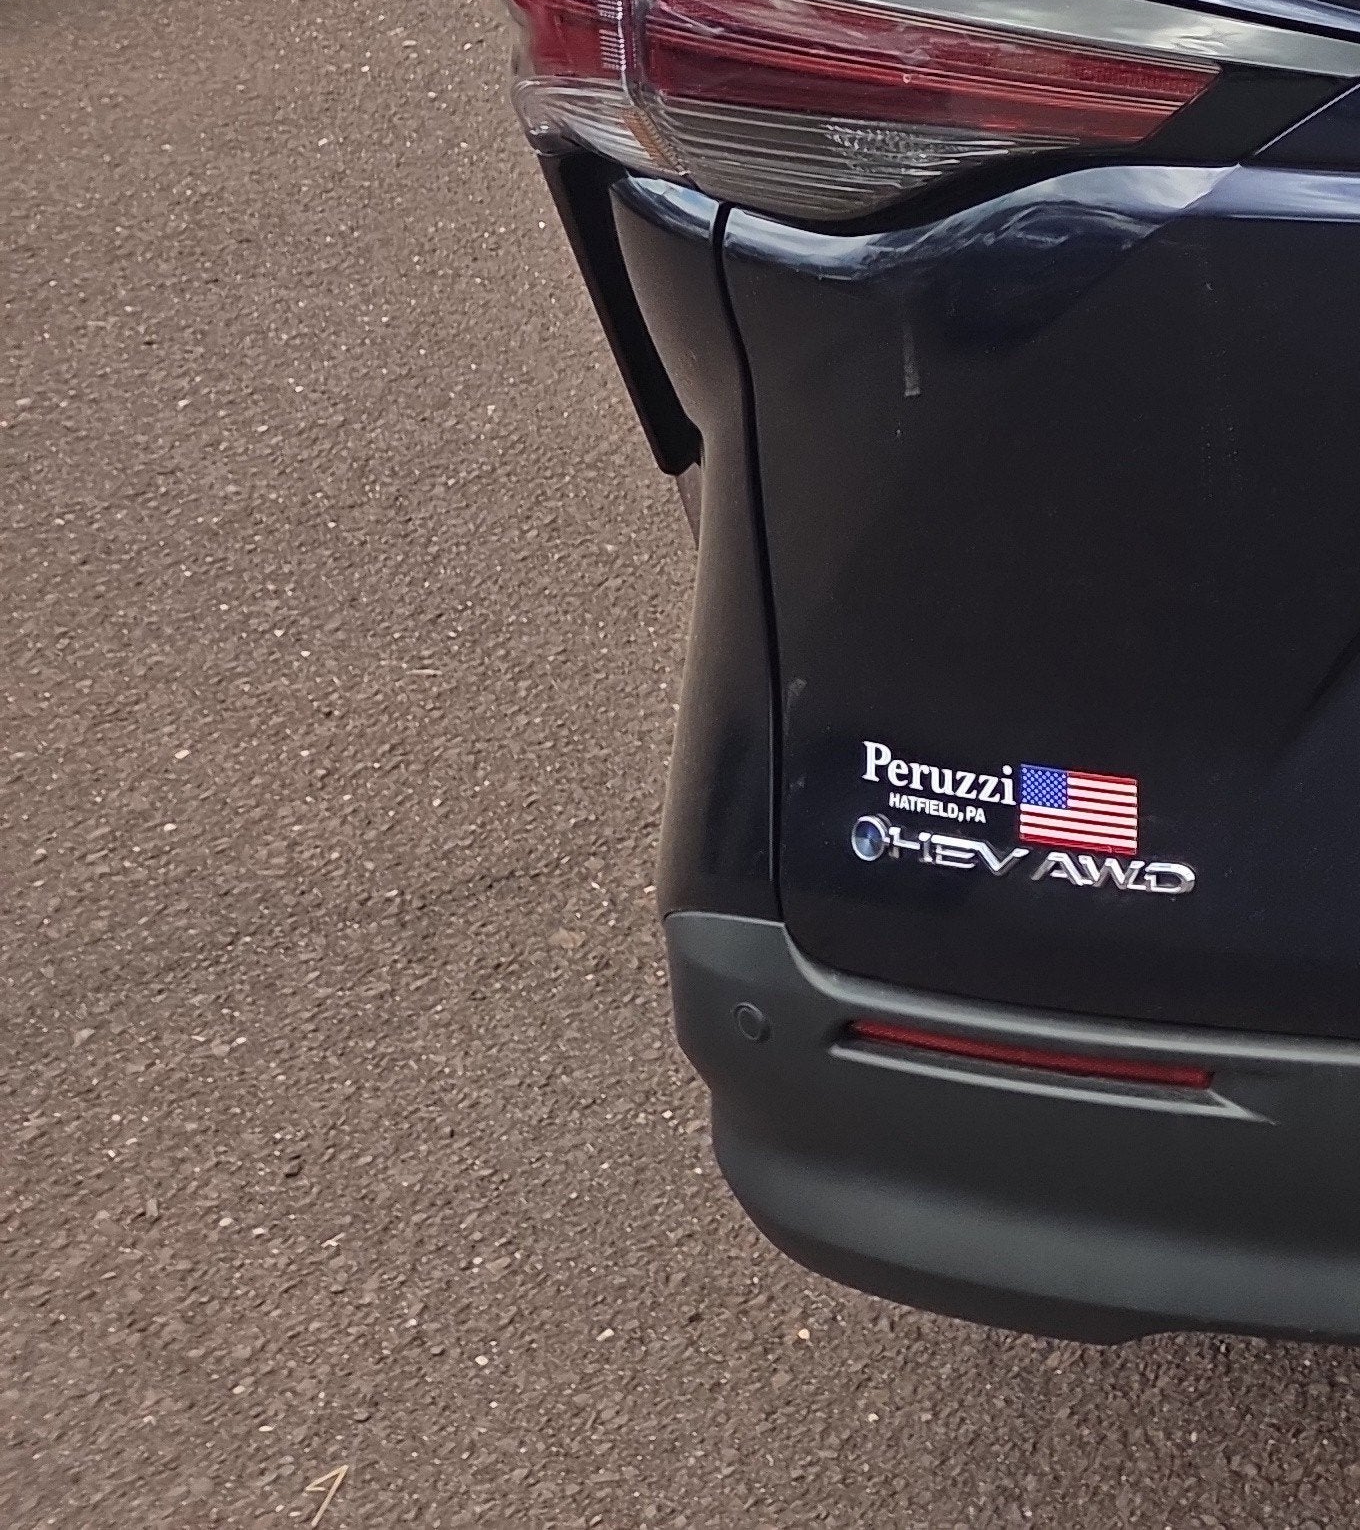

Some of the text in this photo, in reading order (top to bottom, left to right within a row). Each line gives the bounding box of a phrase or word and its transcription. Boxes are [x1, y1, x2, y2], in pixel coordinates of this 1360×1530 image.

[861, 740, 1016, 806] Peruzzi
[888, 792, 986, 824] HATFIELD, PA
[888, 826, 1197, 894] HEV AWD
